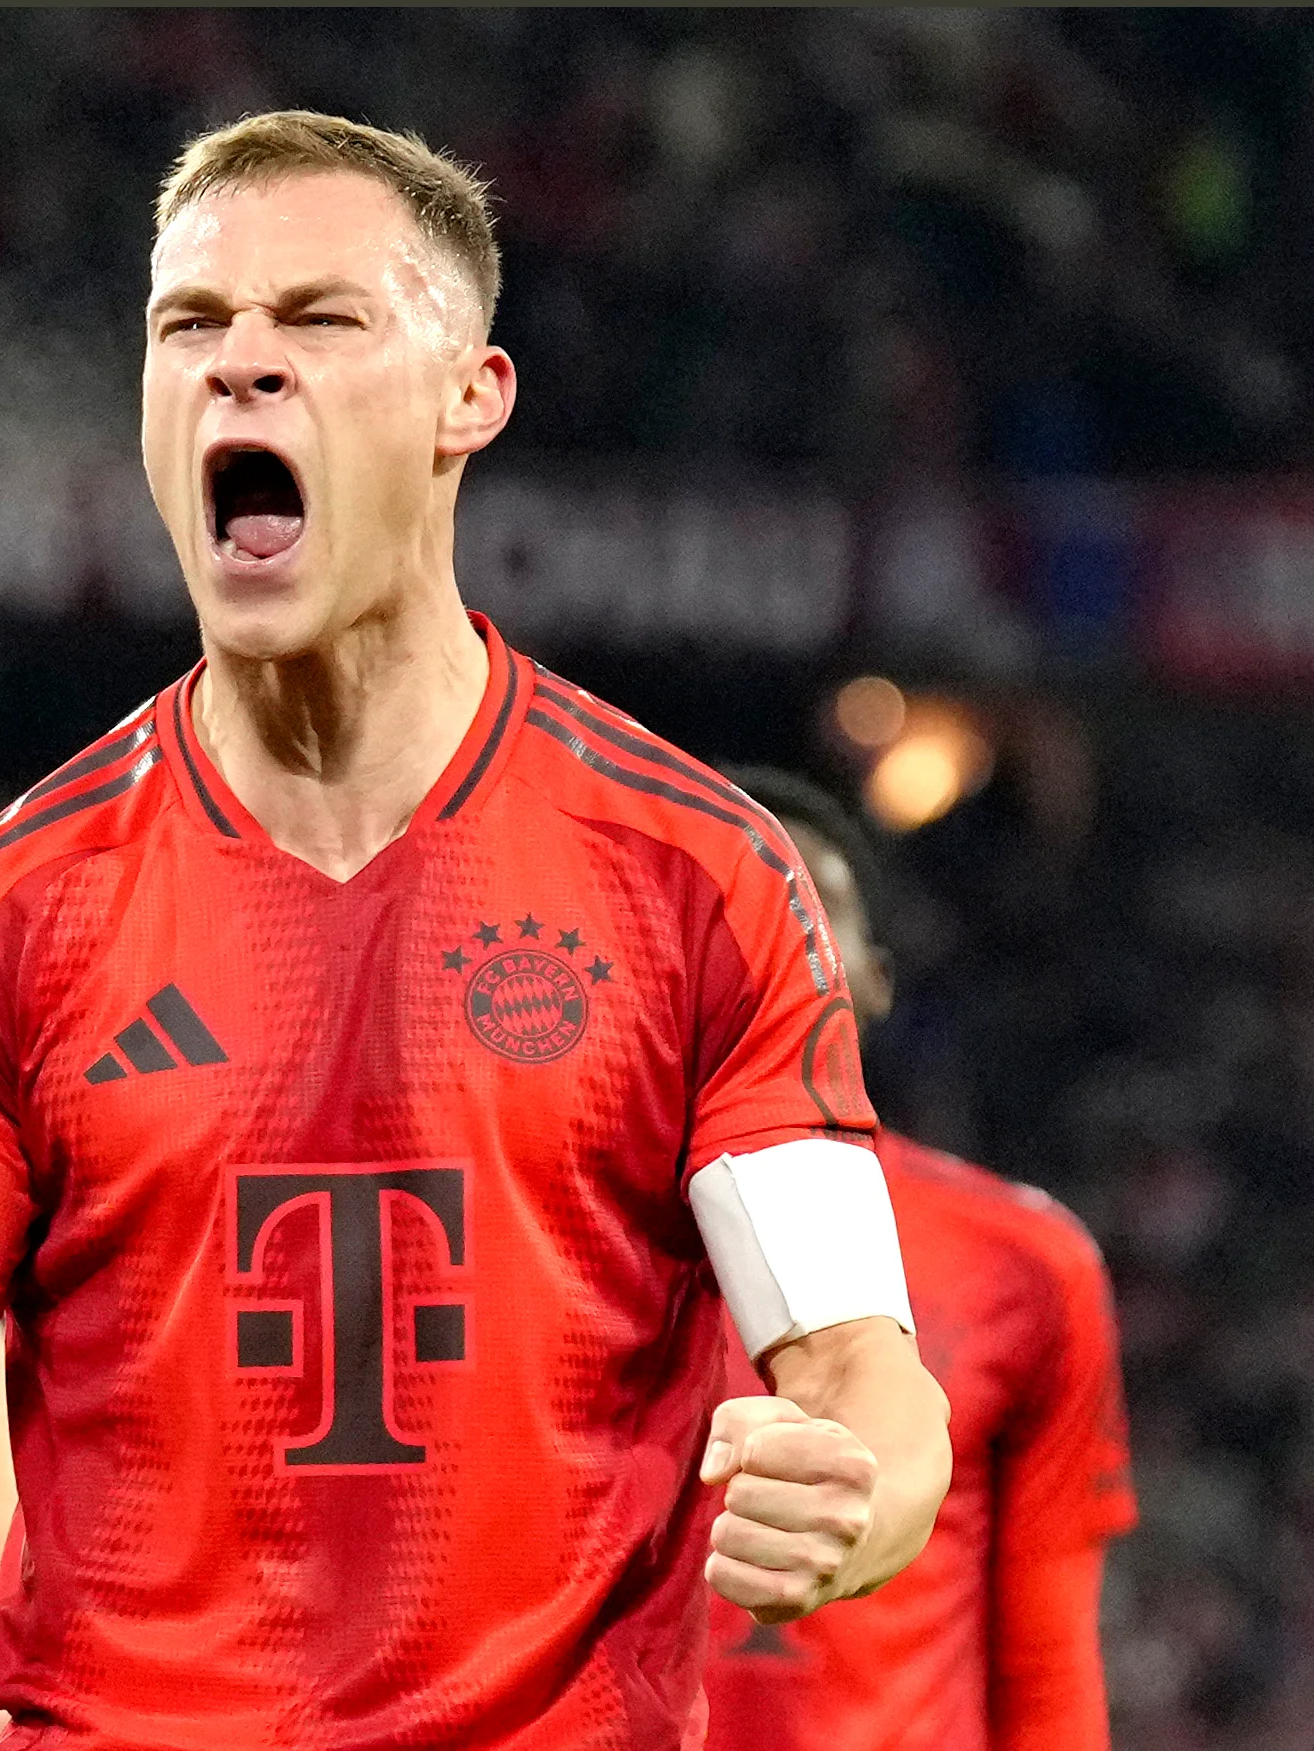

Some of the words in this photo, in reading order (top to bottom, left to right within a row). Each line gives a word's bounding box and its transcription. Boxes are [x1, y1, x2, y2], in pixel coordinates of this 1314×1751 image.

[476, 969, 501, 995] FC
[501, 957, 579, 1001] BAYERN
[236, 1168, 466, 1466] T
